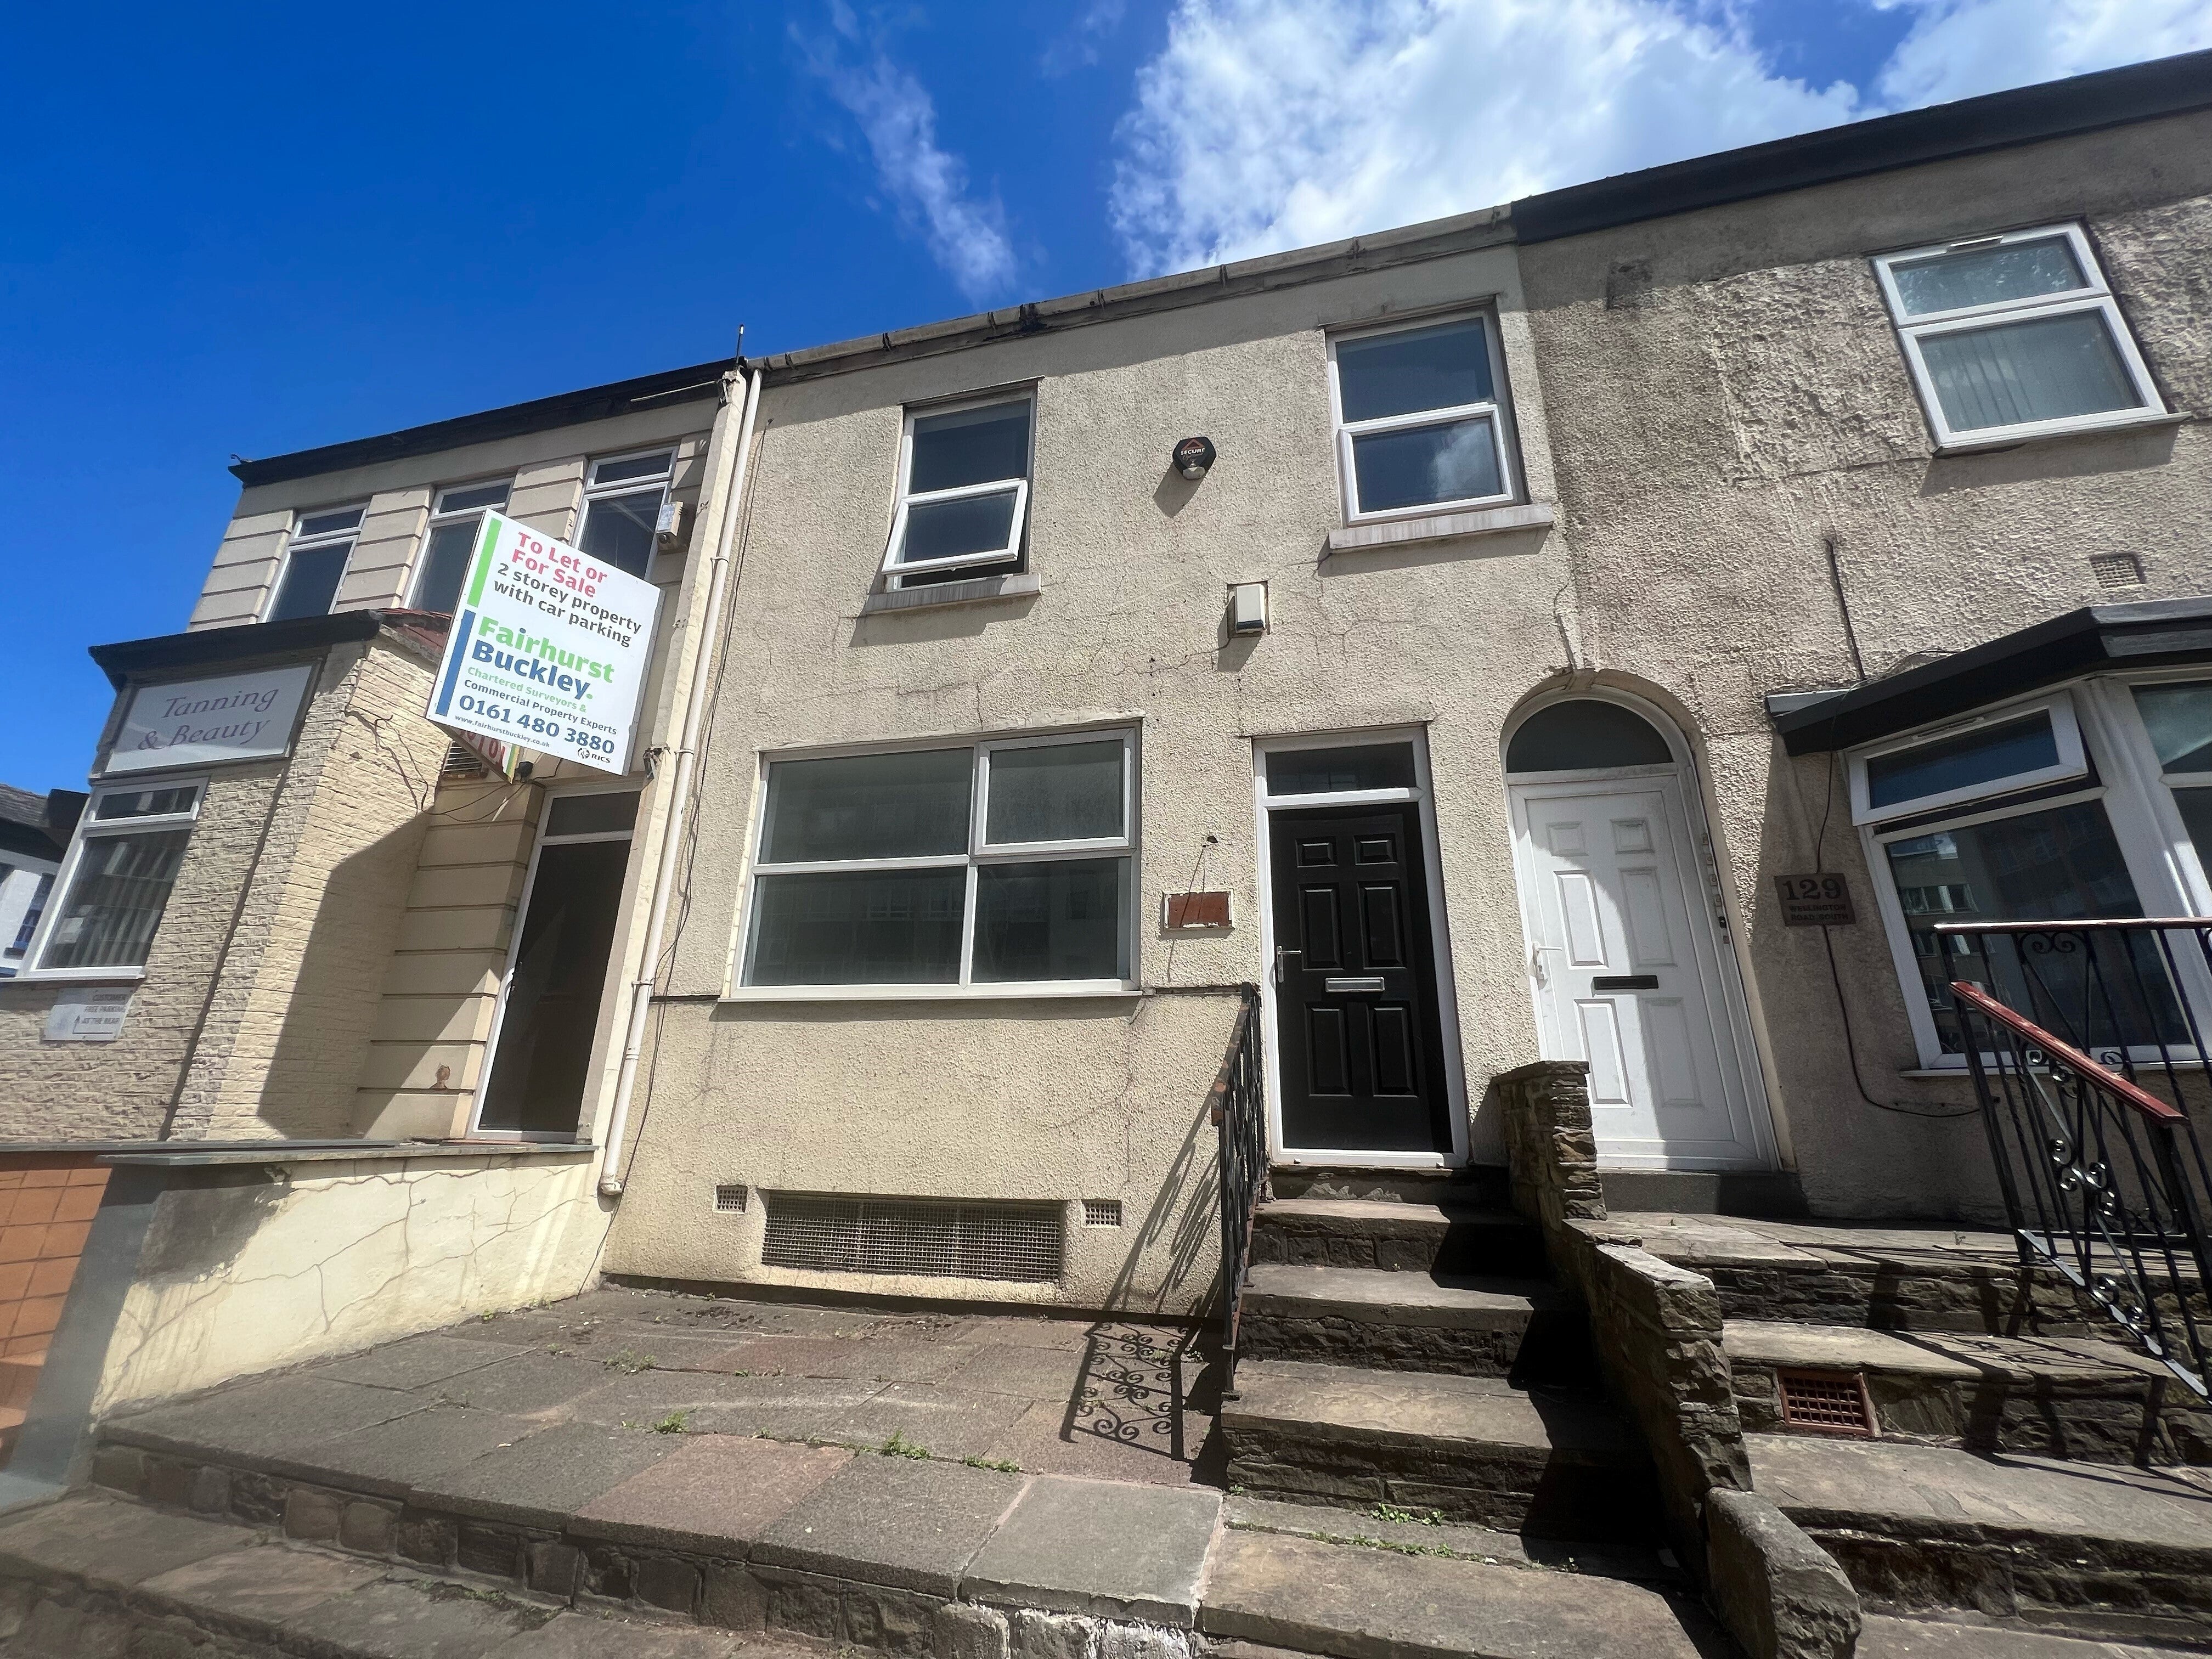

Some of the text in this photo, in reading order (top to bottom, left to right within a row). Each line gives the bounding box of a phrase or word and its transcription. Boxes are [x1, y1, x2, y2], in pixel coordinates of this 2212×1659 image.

[511, 549, 596, 597] For Sale
[518, 531, 608, 583] To Let or
[494, 580, 631, 647] with car parking
[498, 562, 642, 634] 2 storey property
[478, 616, 614, 683] Fairhurst
[161, 688, 279, 718] Tanning
[464, 679, 617, 735] Commercial Property Experts
[467, 666, 586, 713] Chartered Surveyors &
[137, 719, 270, 751] & Beauty
[455, 715, 550, 748] www.fairhurstbuckley.co.uk
[459, 695, 614, 754] 0161 480 3880
[591, 753, 611, 763] RICS
[1783, 878, 1841, 900] 129
